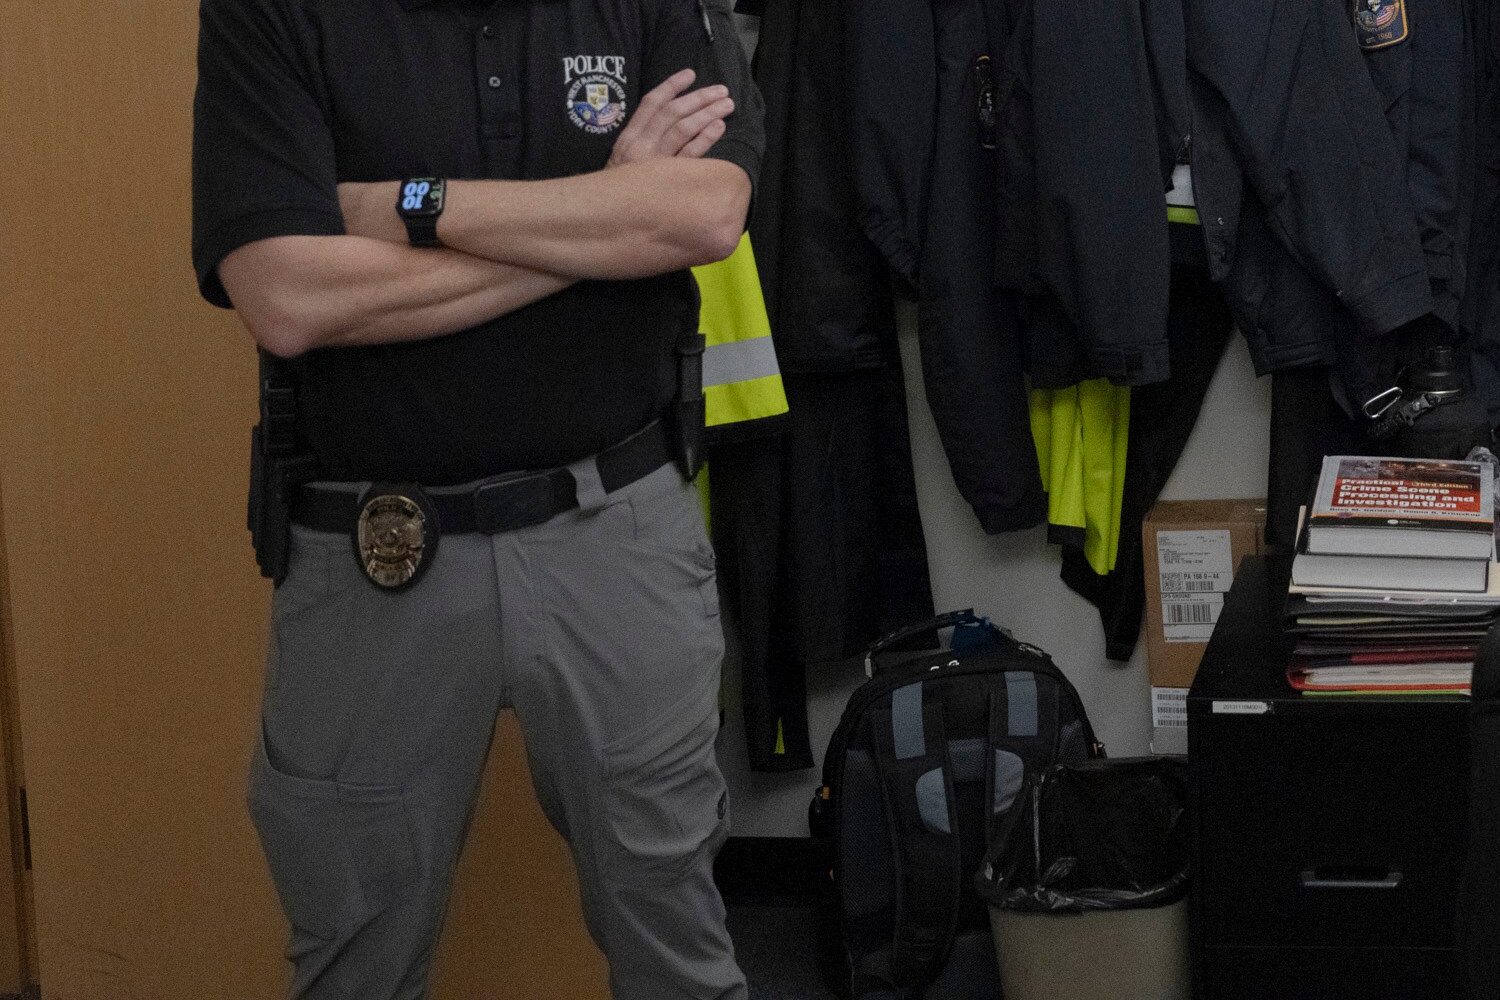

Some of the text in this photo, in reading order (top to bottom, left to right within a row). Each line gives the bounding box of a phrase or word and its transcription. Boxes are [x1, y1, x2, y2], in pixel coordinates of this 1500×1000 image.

[562, 54, 627, 85] POLICE
[1341, 478, 1404, 486] Practical
[1340, 484, 1450, 494] Crime Scene
[1339, 491, 1475, 503] Processing and
[1337, 498, 1457, 509] Investigation
